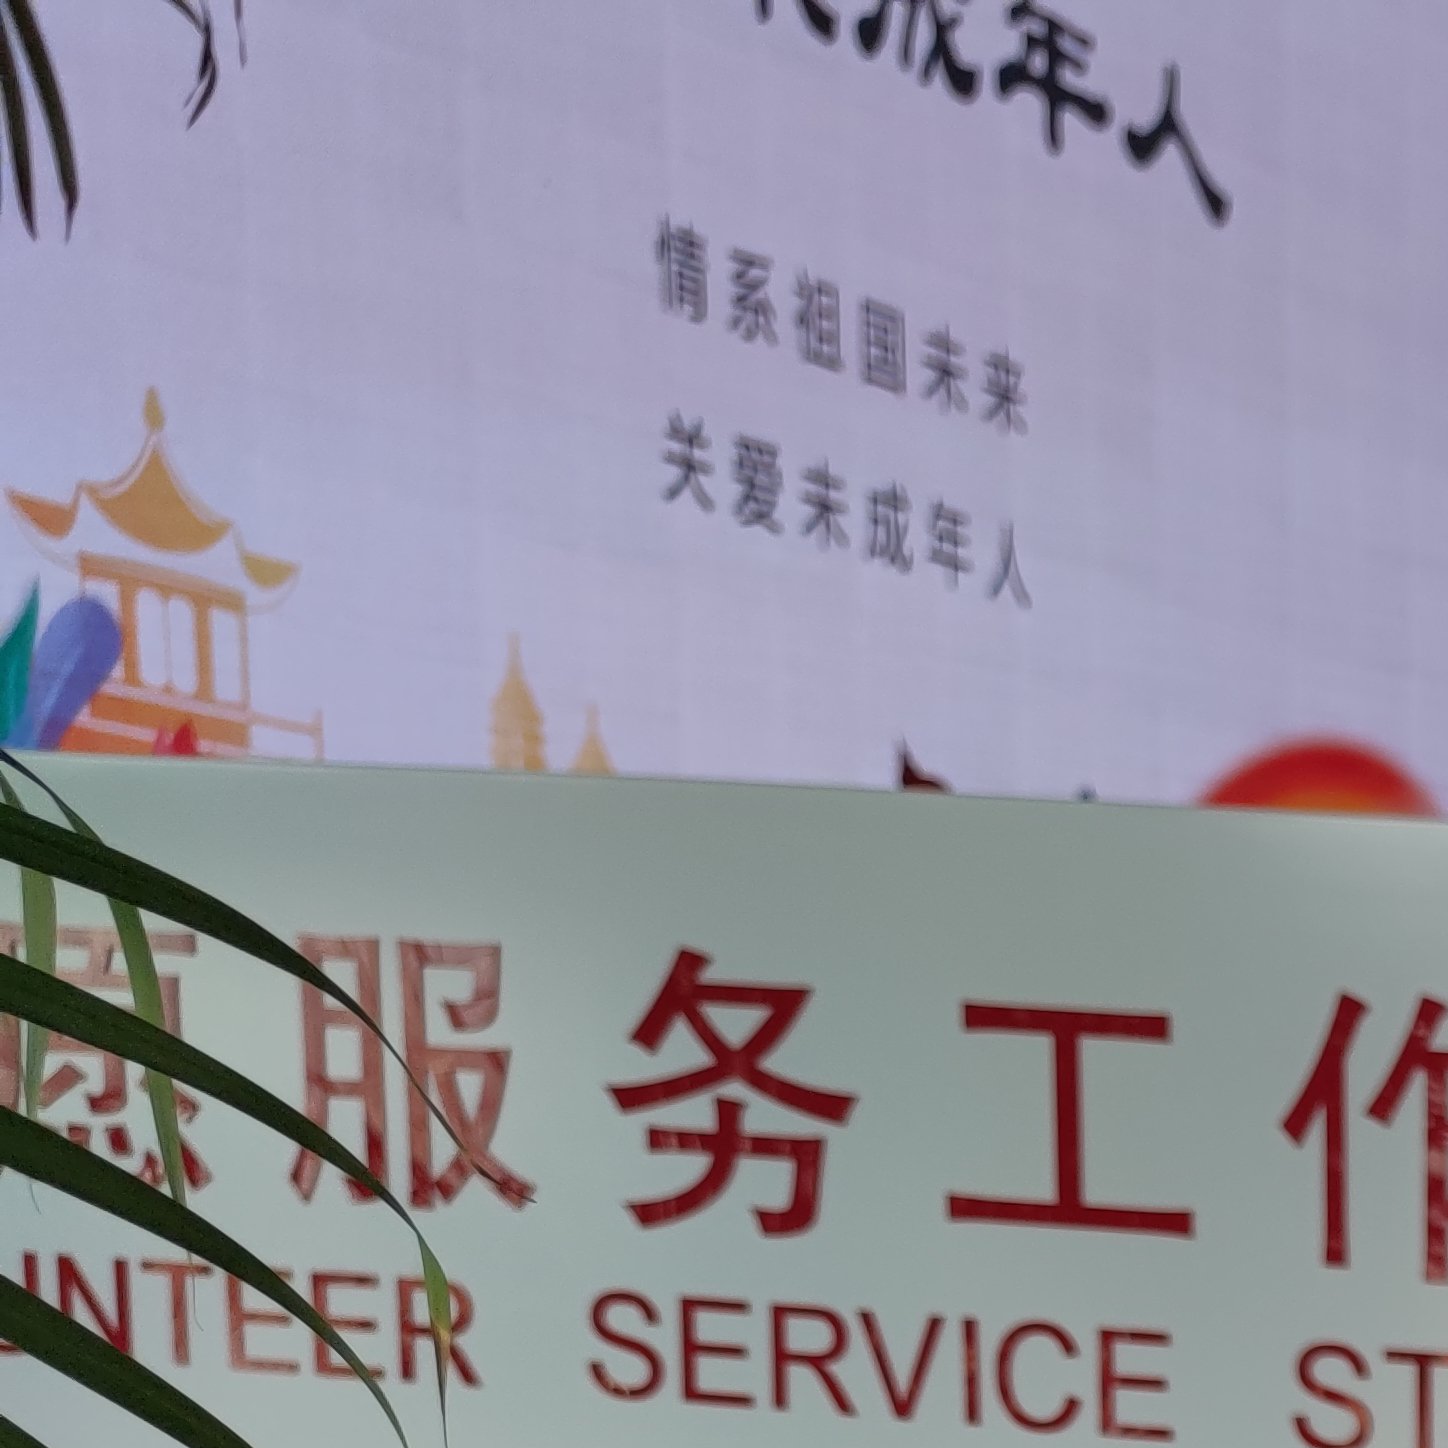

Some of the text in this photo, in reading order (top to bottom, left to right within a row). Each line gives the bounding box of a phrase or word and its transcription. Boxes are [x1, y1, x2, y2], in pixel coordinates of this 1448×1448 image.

[755, 0, 1231, 225] 成年人
[656, 213, 1028, 437] 情系祖国未来
[663, 407, 1034, 610] 关爱未成年人
[588, 1289, 1176, 1443] SERVICE
